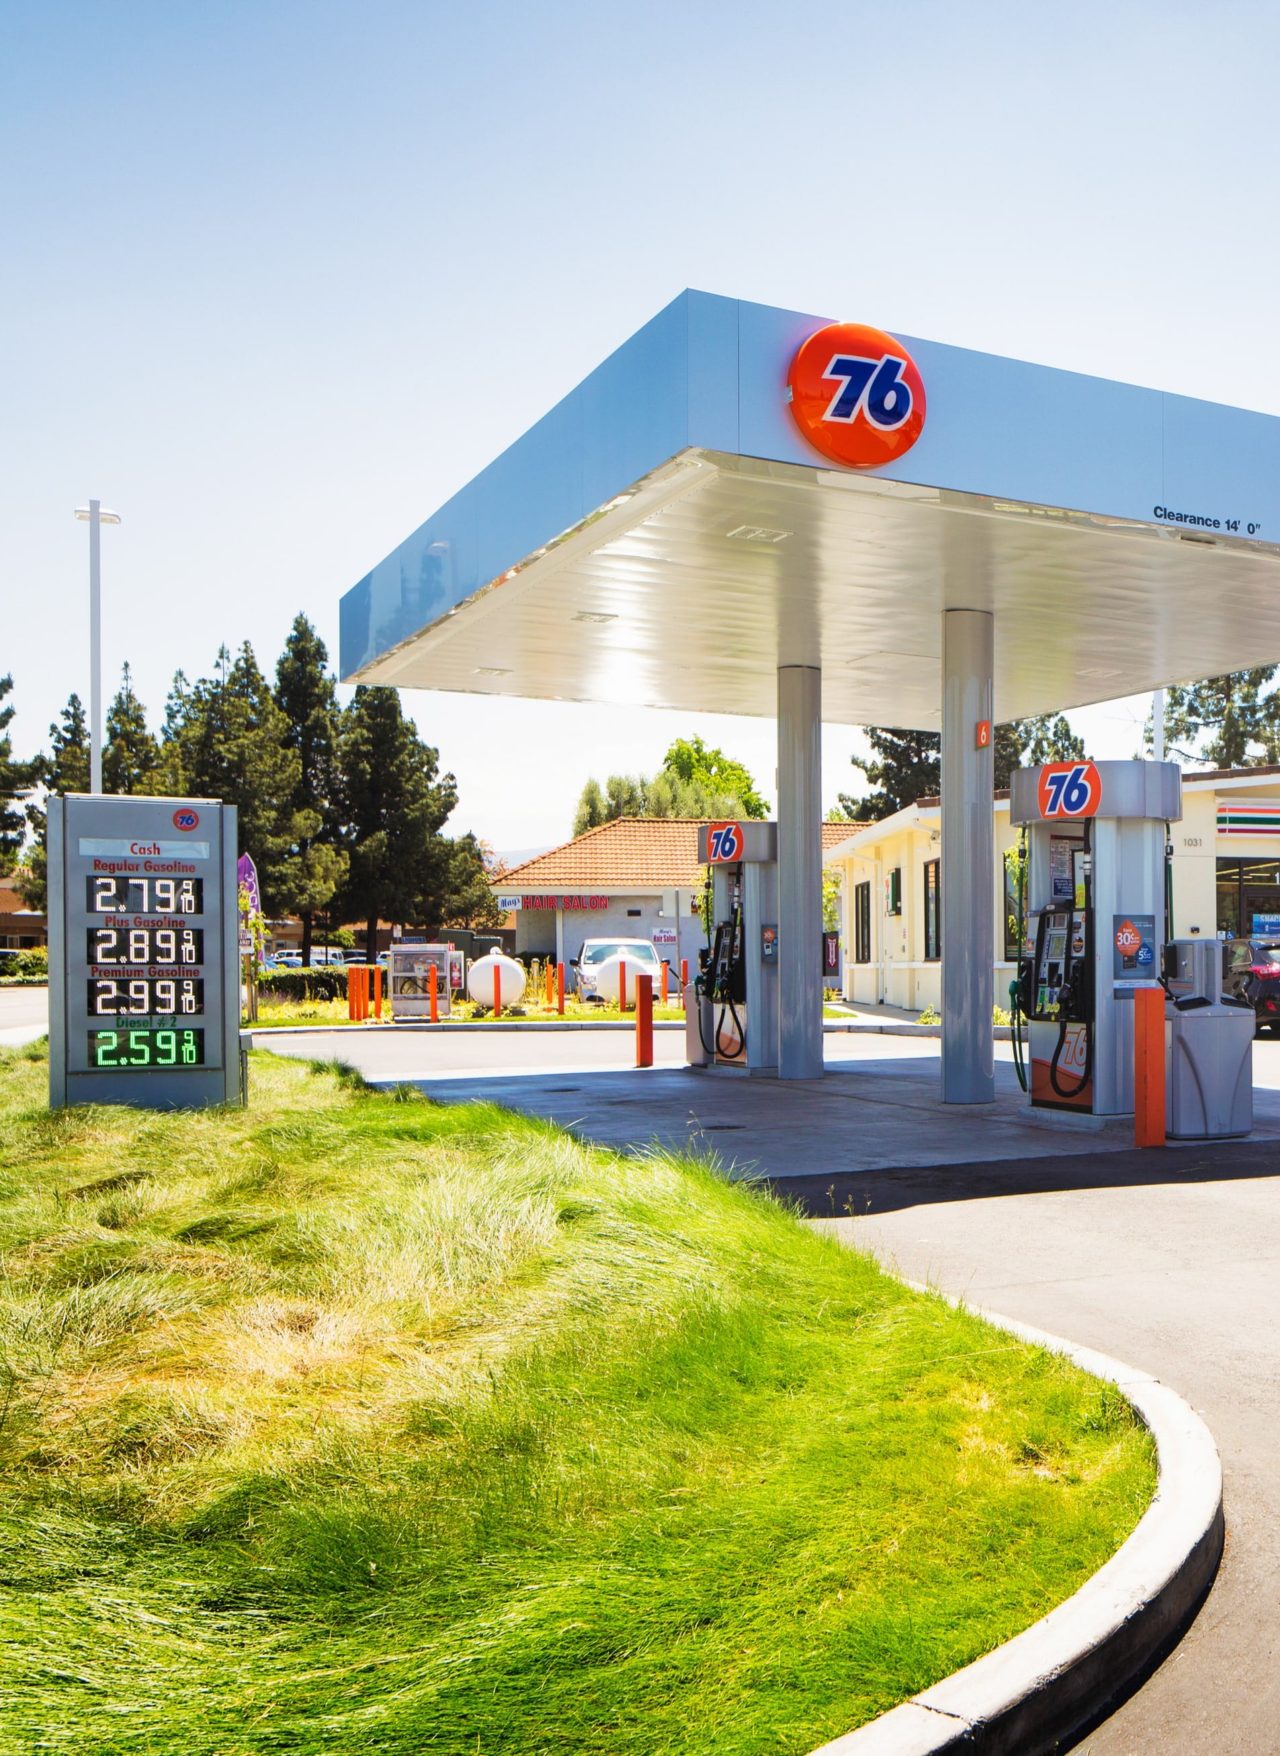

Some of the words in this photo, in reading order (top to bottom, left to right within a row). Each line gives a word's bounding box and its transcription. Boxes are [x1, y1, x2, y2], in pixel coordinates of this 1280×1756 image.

[821, 354, 913, 432] 76
[1153, 505, 1221, 528] Clearance
[1044, 764, 1091, 816] 76
[179, 814, 195, 826] 76
[130, 843, 161, 855] Cash
[710, 825, 737, 860] 76
[1183, 838, 1203, 847] 1031
[93, 859, 140, 874] Regular
[144, 861, 196, 873] Gasoline
[96, 878, 175, 913] 2.79
[521, 896, 557, 910] HAIR
[563, 896, 609, 910] SALON
[105, 916, 129, 928] Plus
[134, 916, 186, 928] Gasoline
[97, 930, 175, 963] 2.89
[91, 966, 144, 977] Premium
[148, 966, 200, 978] Gasoline
[97, 980, 175, 1014] 2.99
[116, 1017, 152, 1028] Diesel
[97, 1031, 176, 1065] 2.59
